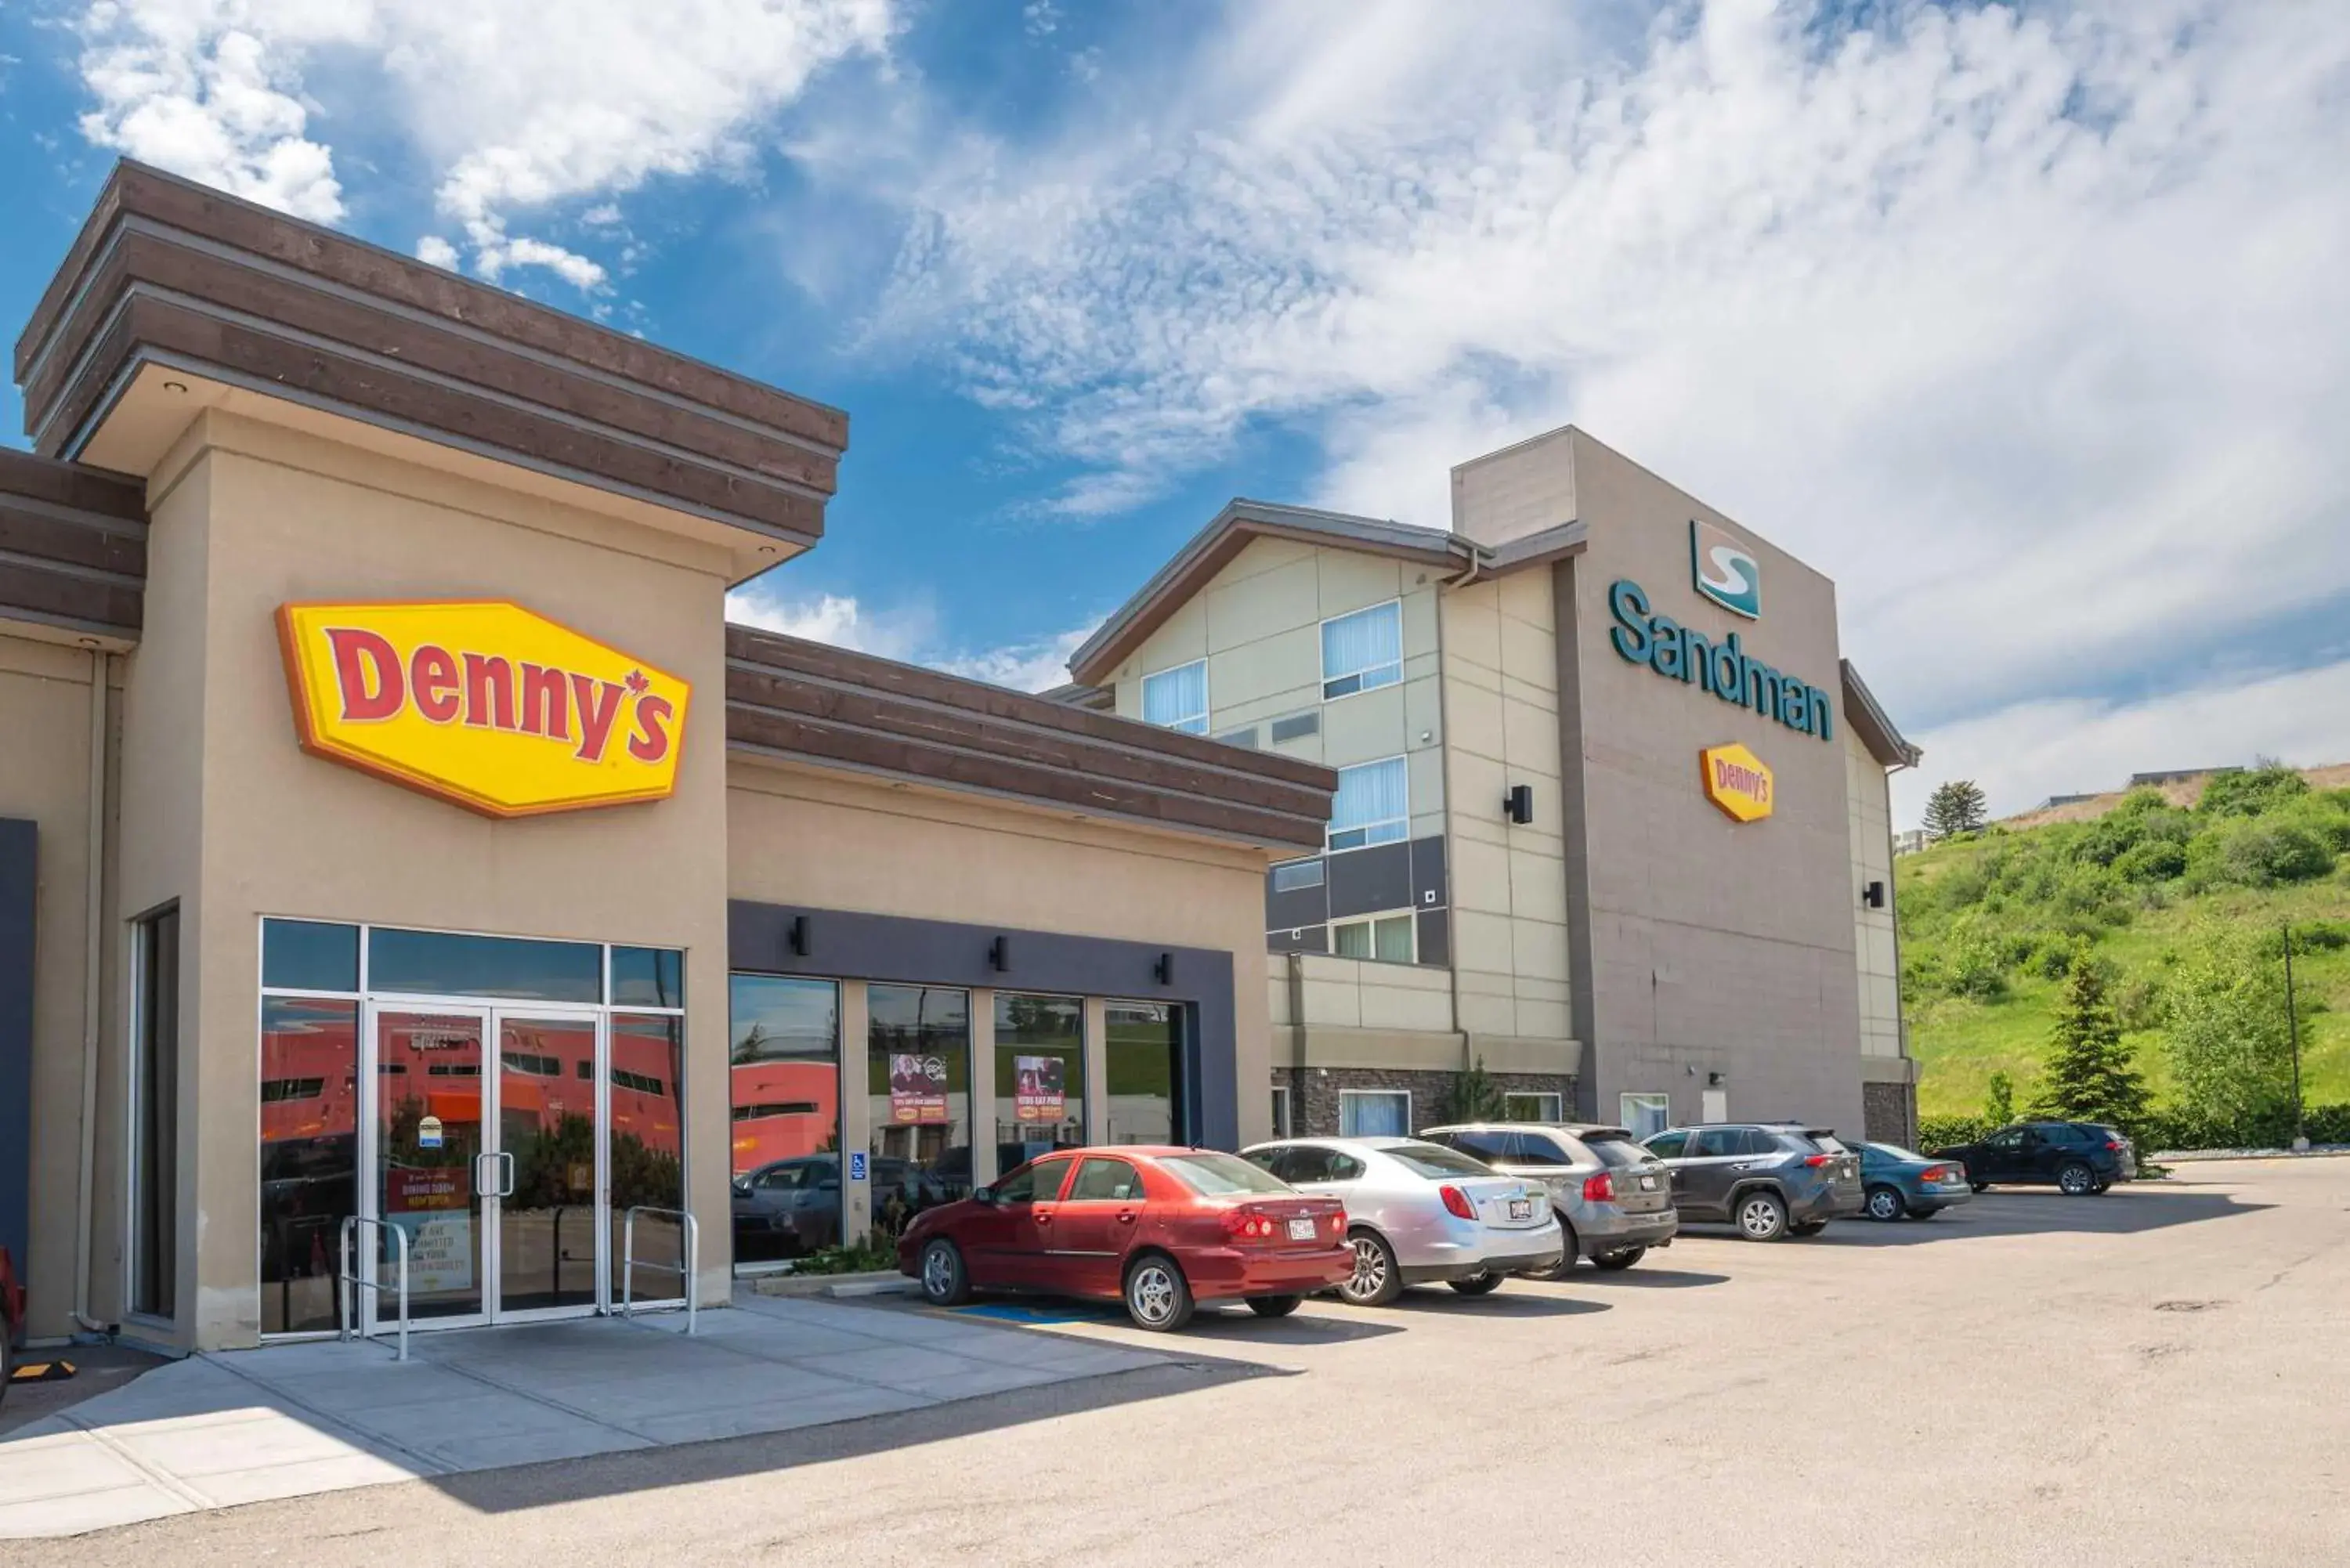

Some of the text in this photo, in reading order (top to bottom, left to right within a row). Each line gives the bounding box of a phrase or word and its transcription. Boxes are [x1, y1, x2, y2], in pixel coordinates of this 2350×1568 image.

[322, 627, 674, 763] Denny's
[1608, 580, 1833, 742] Sandman
[1715, 758, 1769, 804] Denny's
